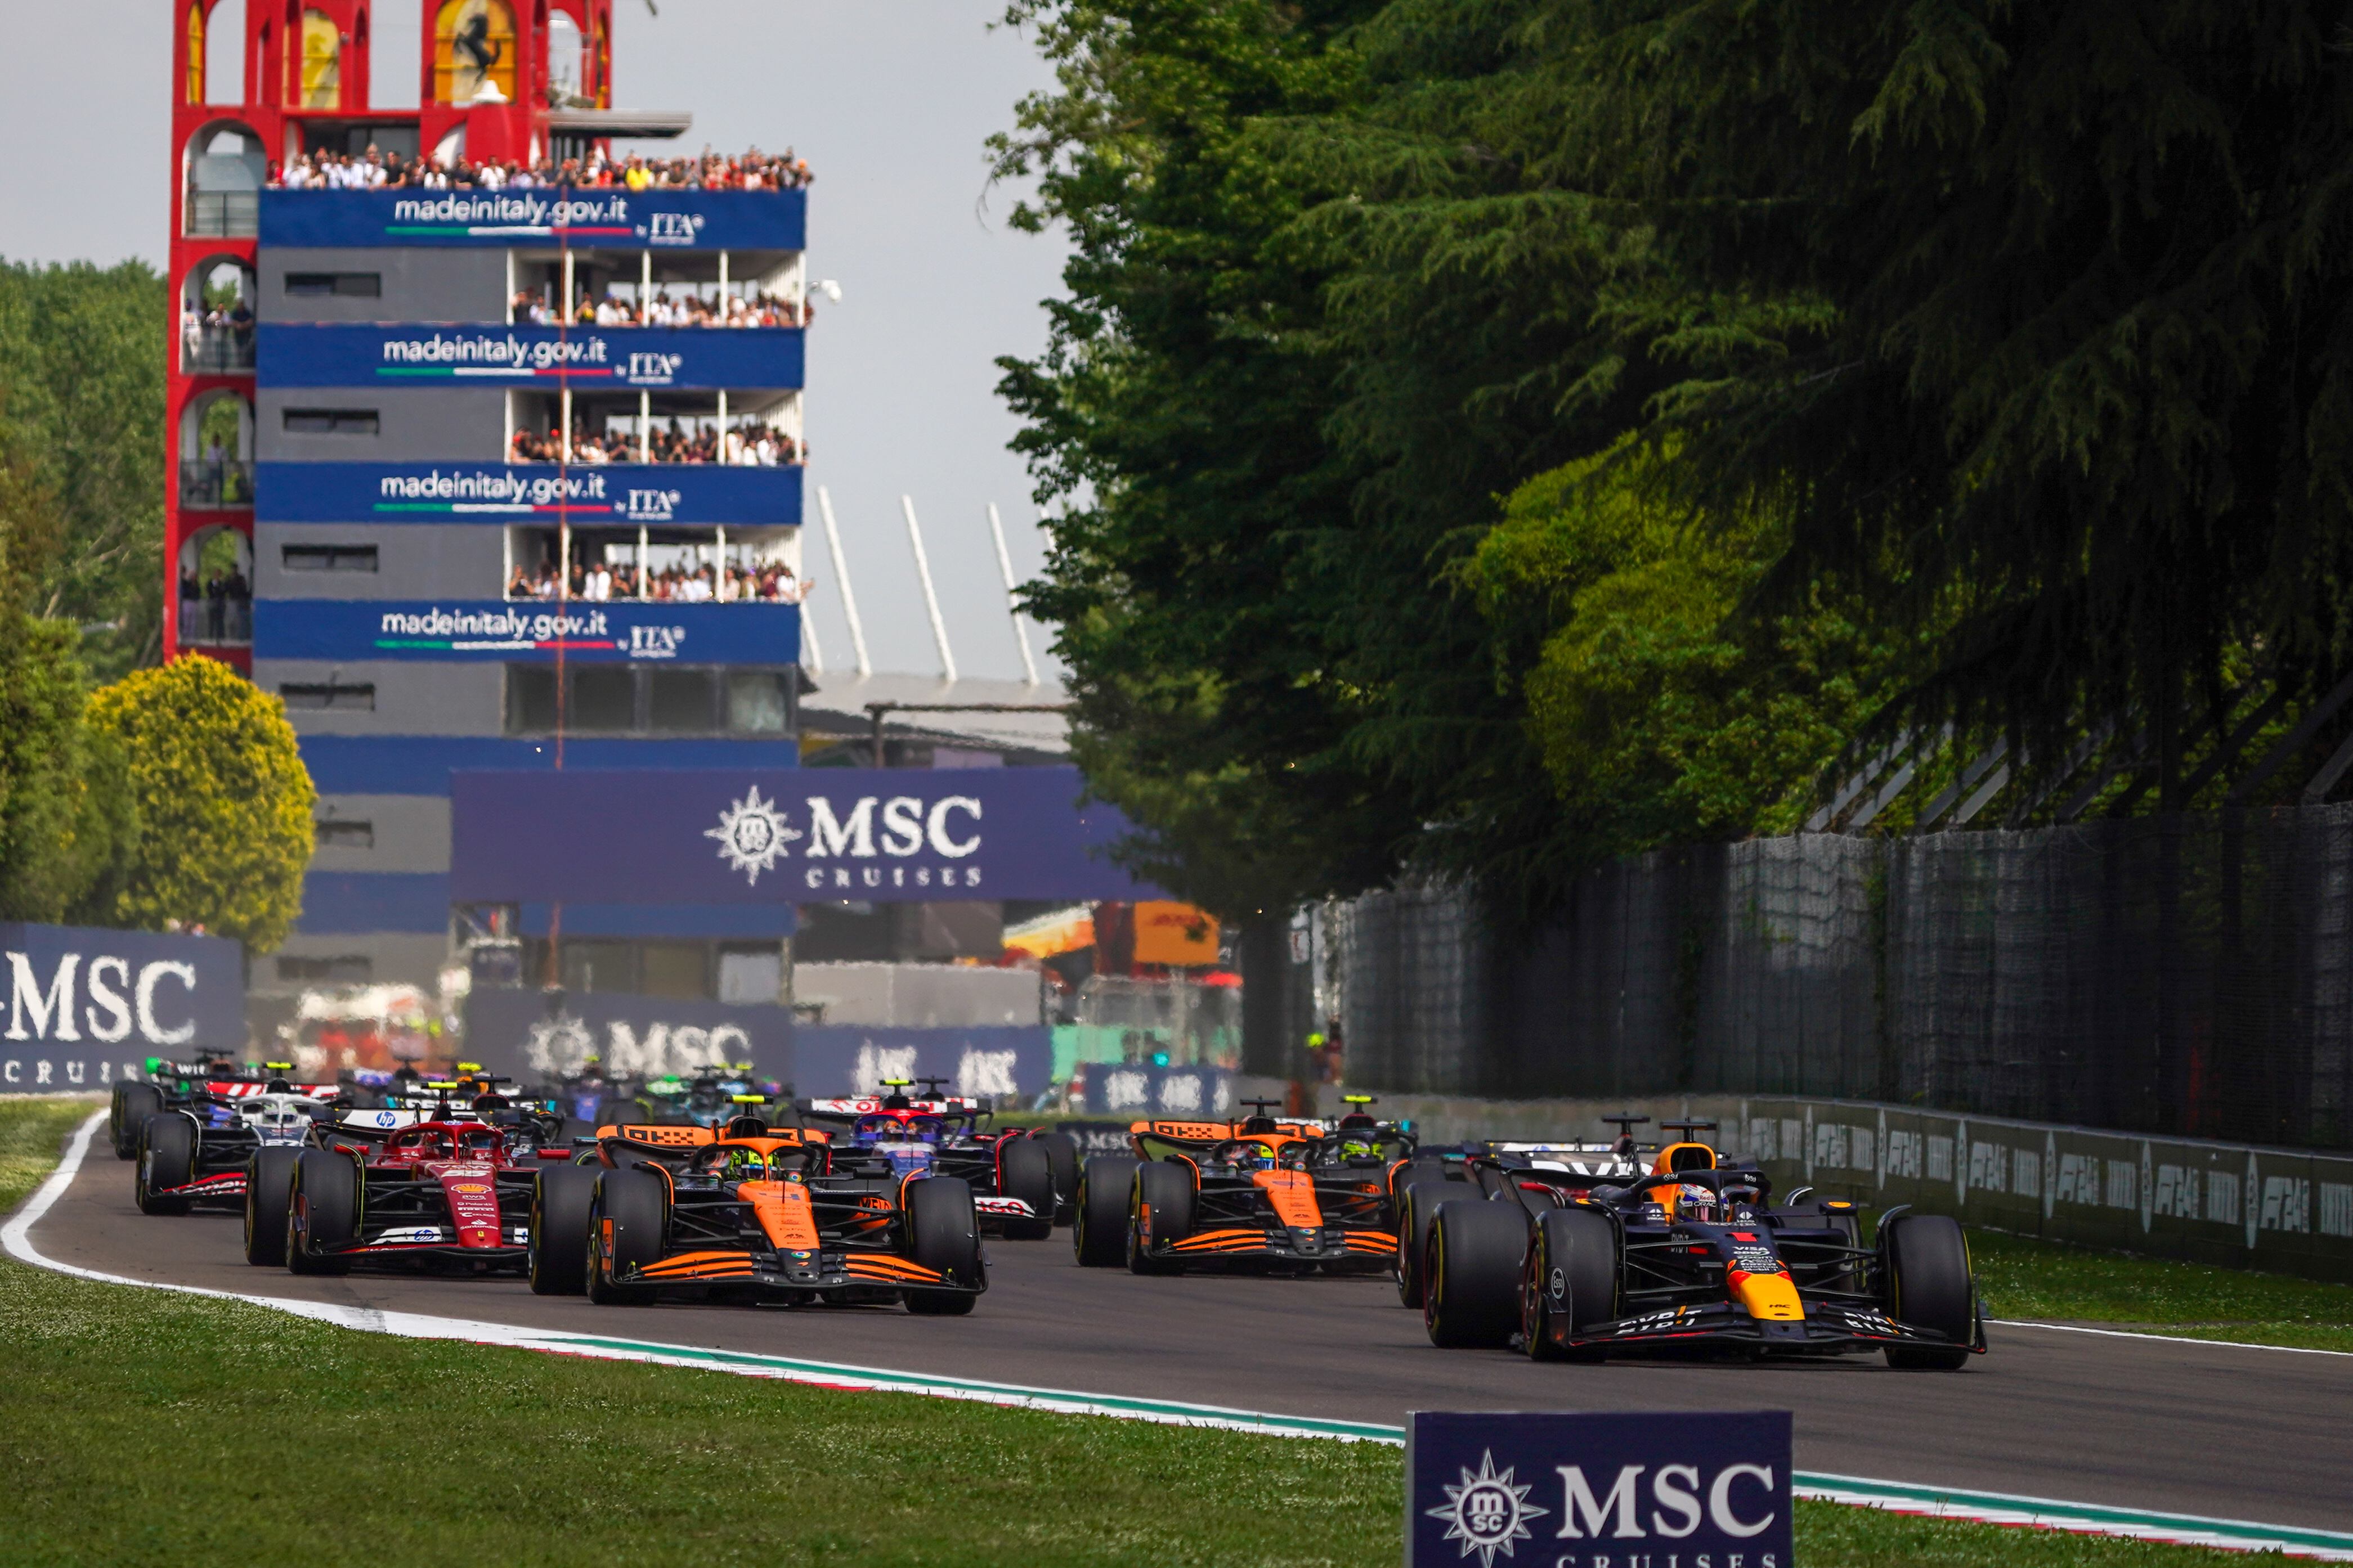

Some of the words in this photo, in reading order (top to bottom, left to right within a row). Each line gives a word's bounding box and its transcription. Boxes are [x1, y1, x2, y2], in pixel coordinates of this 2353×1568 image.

[395, 193, 628, 226] madeinitaly.gov.it
[383, 333, 607, 369] madeinitaly.gov.it
[380, 469, 606, 504] madeinitaly.gov.it
[382, 606, 607, 641] madeinitaly.gov.it
[805, 796, 982, 858] MSC
[805, 866, 982, 889] CRUISES
[5, 951, 196, 1045] MSC
[608, 1021, 752, 1079] MSC
[1556, 1463, 1776, 1539] MSC
